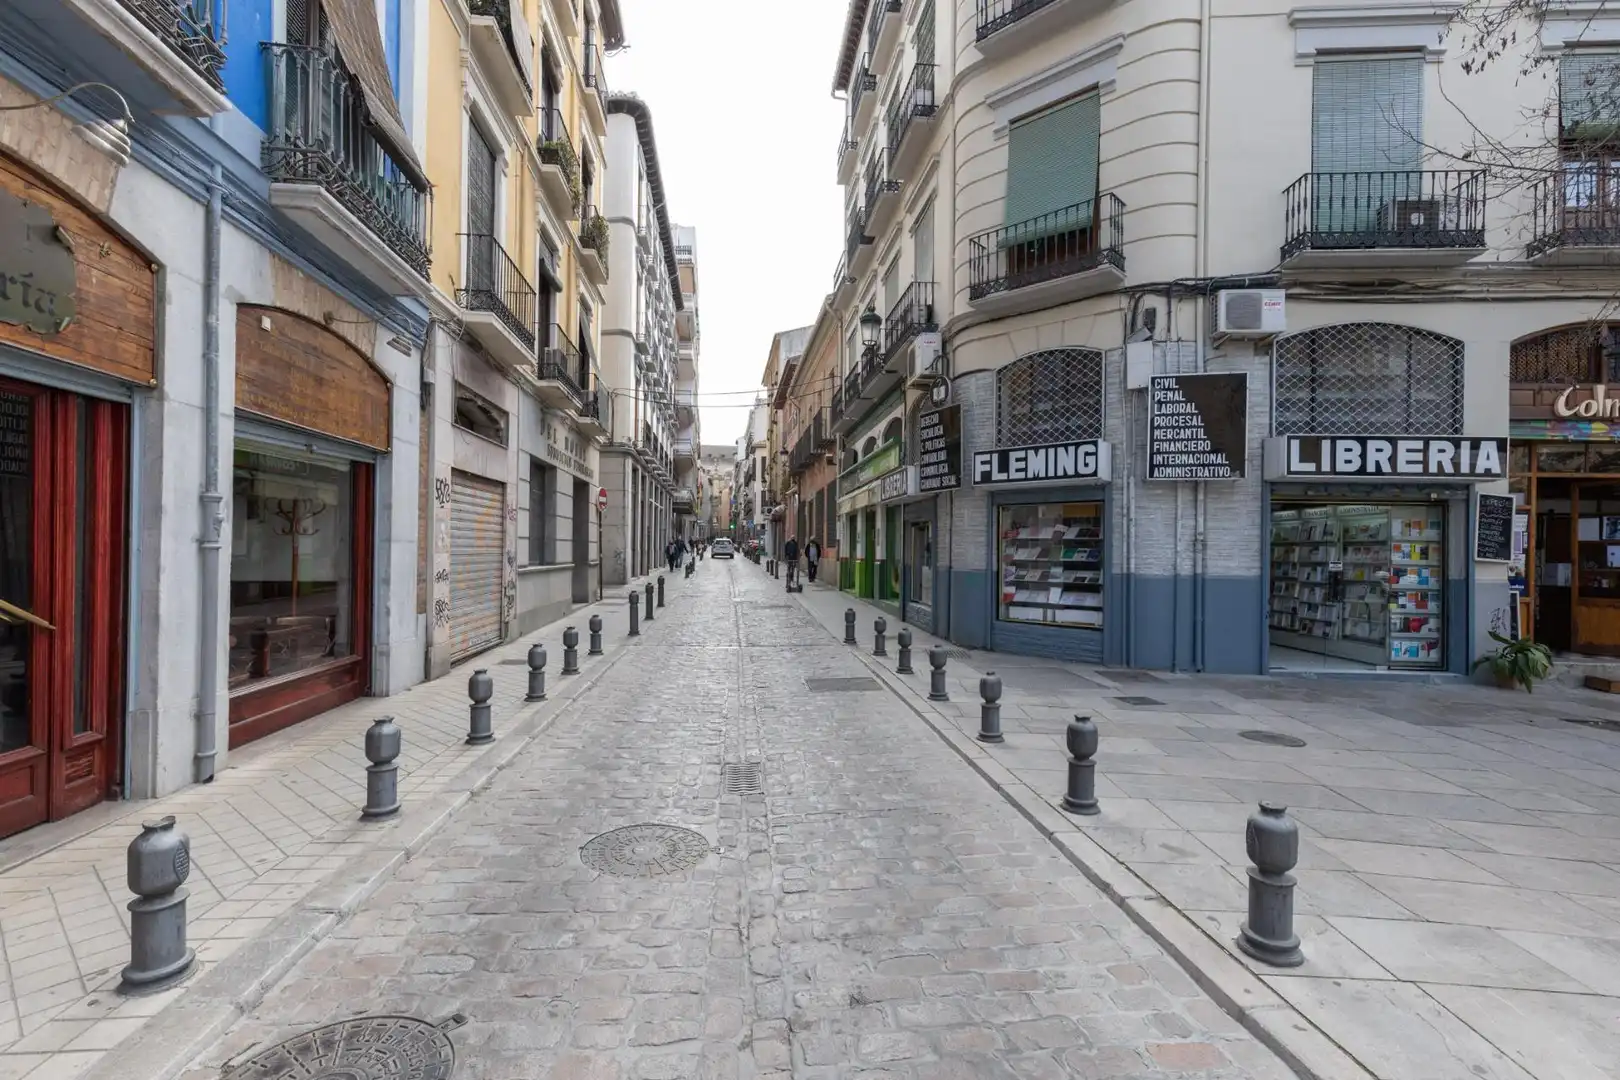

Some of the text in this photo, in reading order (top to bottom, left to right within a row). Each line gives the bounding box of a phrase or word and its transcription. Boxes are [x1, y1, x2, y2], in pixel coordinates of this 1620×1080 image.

[1155, 378, 1179, 389] CIVIL
[1155, 390, 1186, 402] PENAL
[1154, 403, 1198, 415] LABORAL
[1154, 415, 1205, 427] PROCESAL
[1154, 428, 1207, 440] MERCANTIL
[1153, 440, 1211, 452] FINANCIERO
[1153, 453, 1229, 465] INTERNACIONAL
[1290, 438, 1501, 474] LIBRERIA
[975, 444, 1097, 482] FLEMING
[1153, 466, 1231, 478] ADMINISTRATIVO
[882, 470, 907, 500] LIBRERIA
